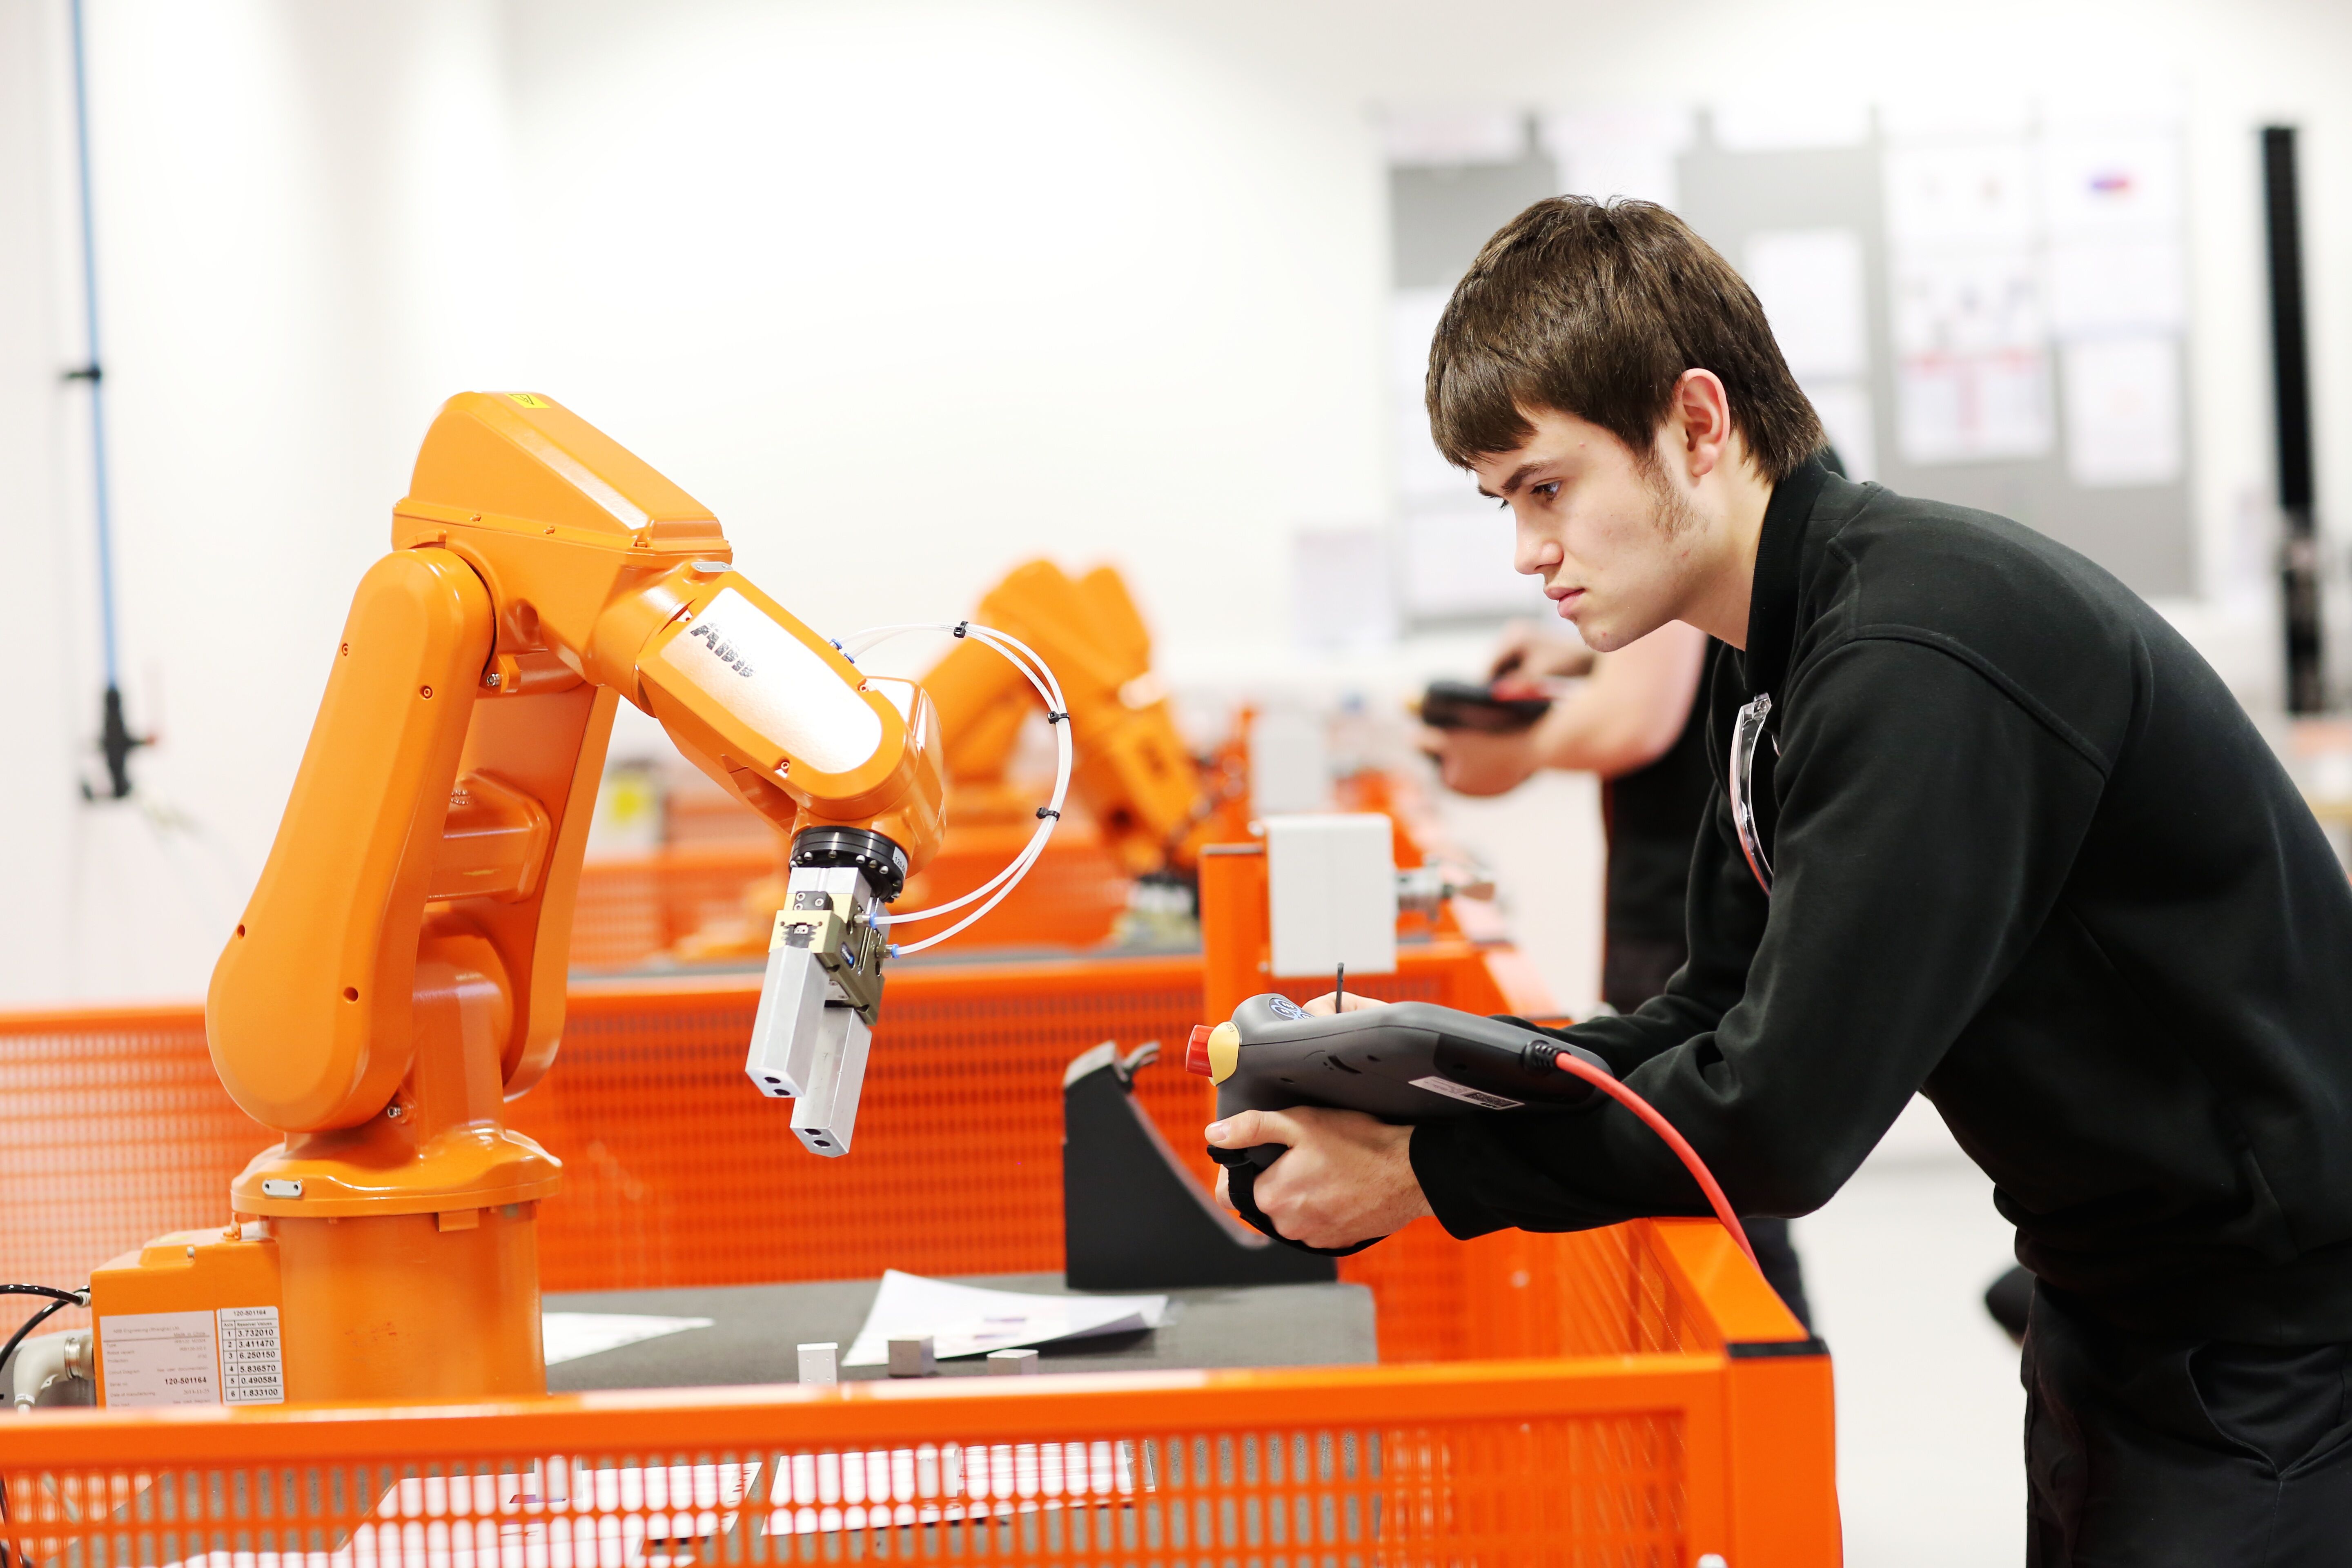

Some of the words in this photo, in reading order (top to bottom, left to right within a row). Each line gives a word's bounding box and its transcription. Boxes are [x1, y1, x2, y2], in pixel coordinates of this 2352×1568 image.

[238, 1329, 274, 1337] 3.732010
[238, 1340, 274, 1348] 3.411470
[239, 1350, 276, 1359] 6.250150
[240, 1364, 276, 1373] 5.836570
[165, 1376, 207, 1385] 120-501164
[241, 1376, 277, 1385] 0.490584
[243, 1388, 278, 1397] 1.833100
